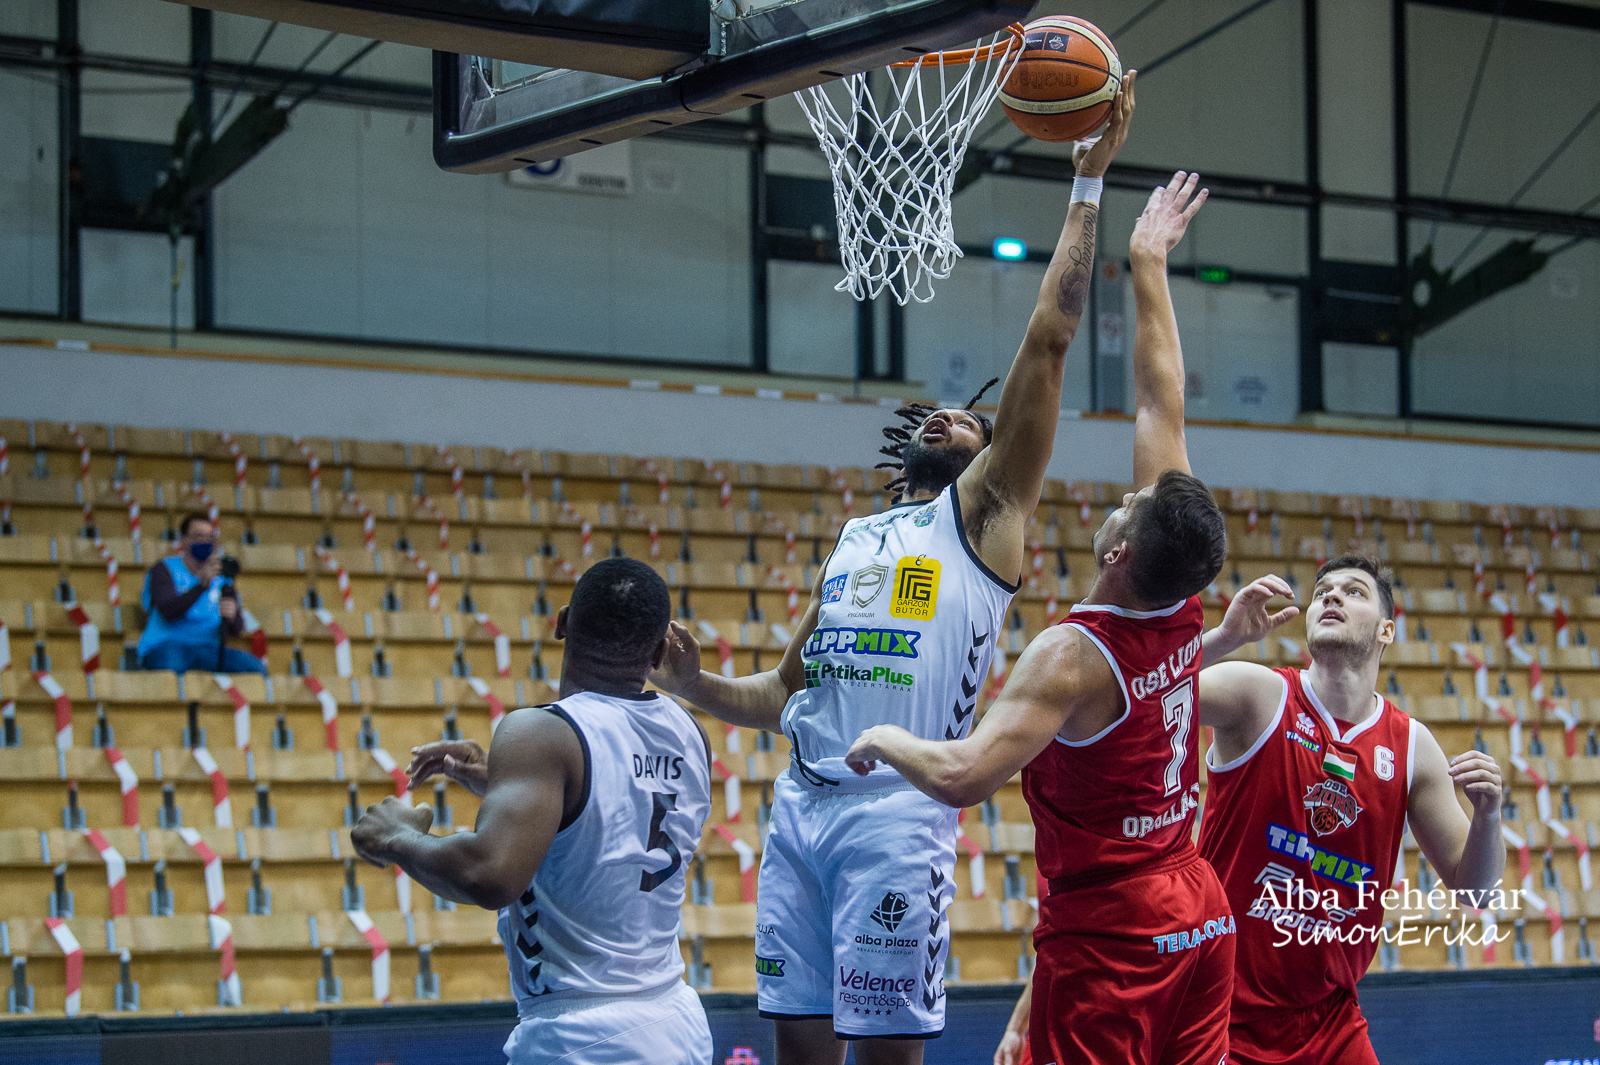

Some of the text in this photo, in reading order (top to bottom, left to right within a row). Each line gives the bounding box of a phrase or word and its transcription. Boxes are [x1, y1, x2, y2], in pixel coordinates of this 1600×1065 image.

[896, 606, 928, 616] BÚTOR
[897, 599, 930, 608] GARZON
[821, 663, 914, 686] PatikaPlus
[1131, 661, 1171, 701] OSE
[1161, 675, 1194, 798] 7
[633, 753, 684, 780] DAVIS
[1374, 745, 1395, 781] 6
[1325, 779, 1347, 795] OSE
[1304, 784, 1356, 821] LIONS
[639, 791, 682, 893] 5
[855, 934, 918, 948] alba plaza
[839, 966, 916, 992] Velence
[839, 991, 912, 1008] resort&spa
